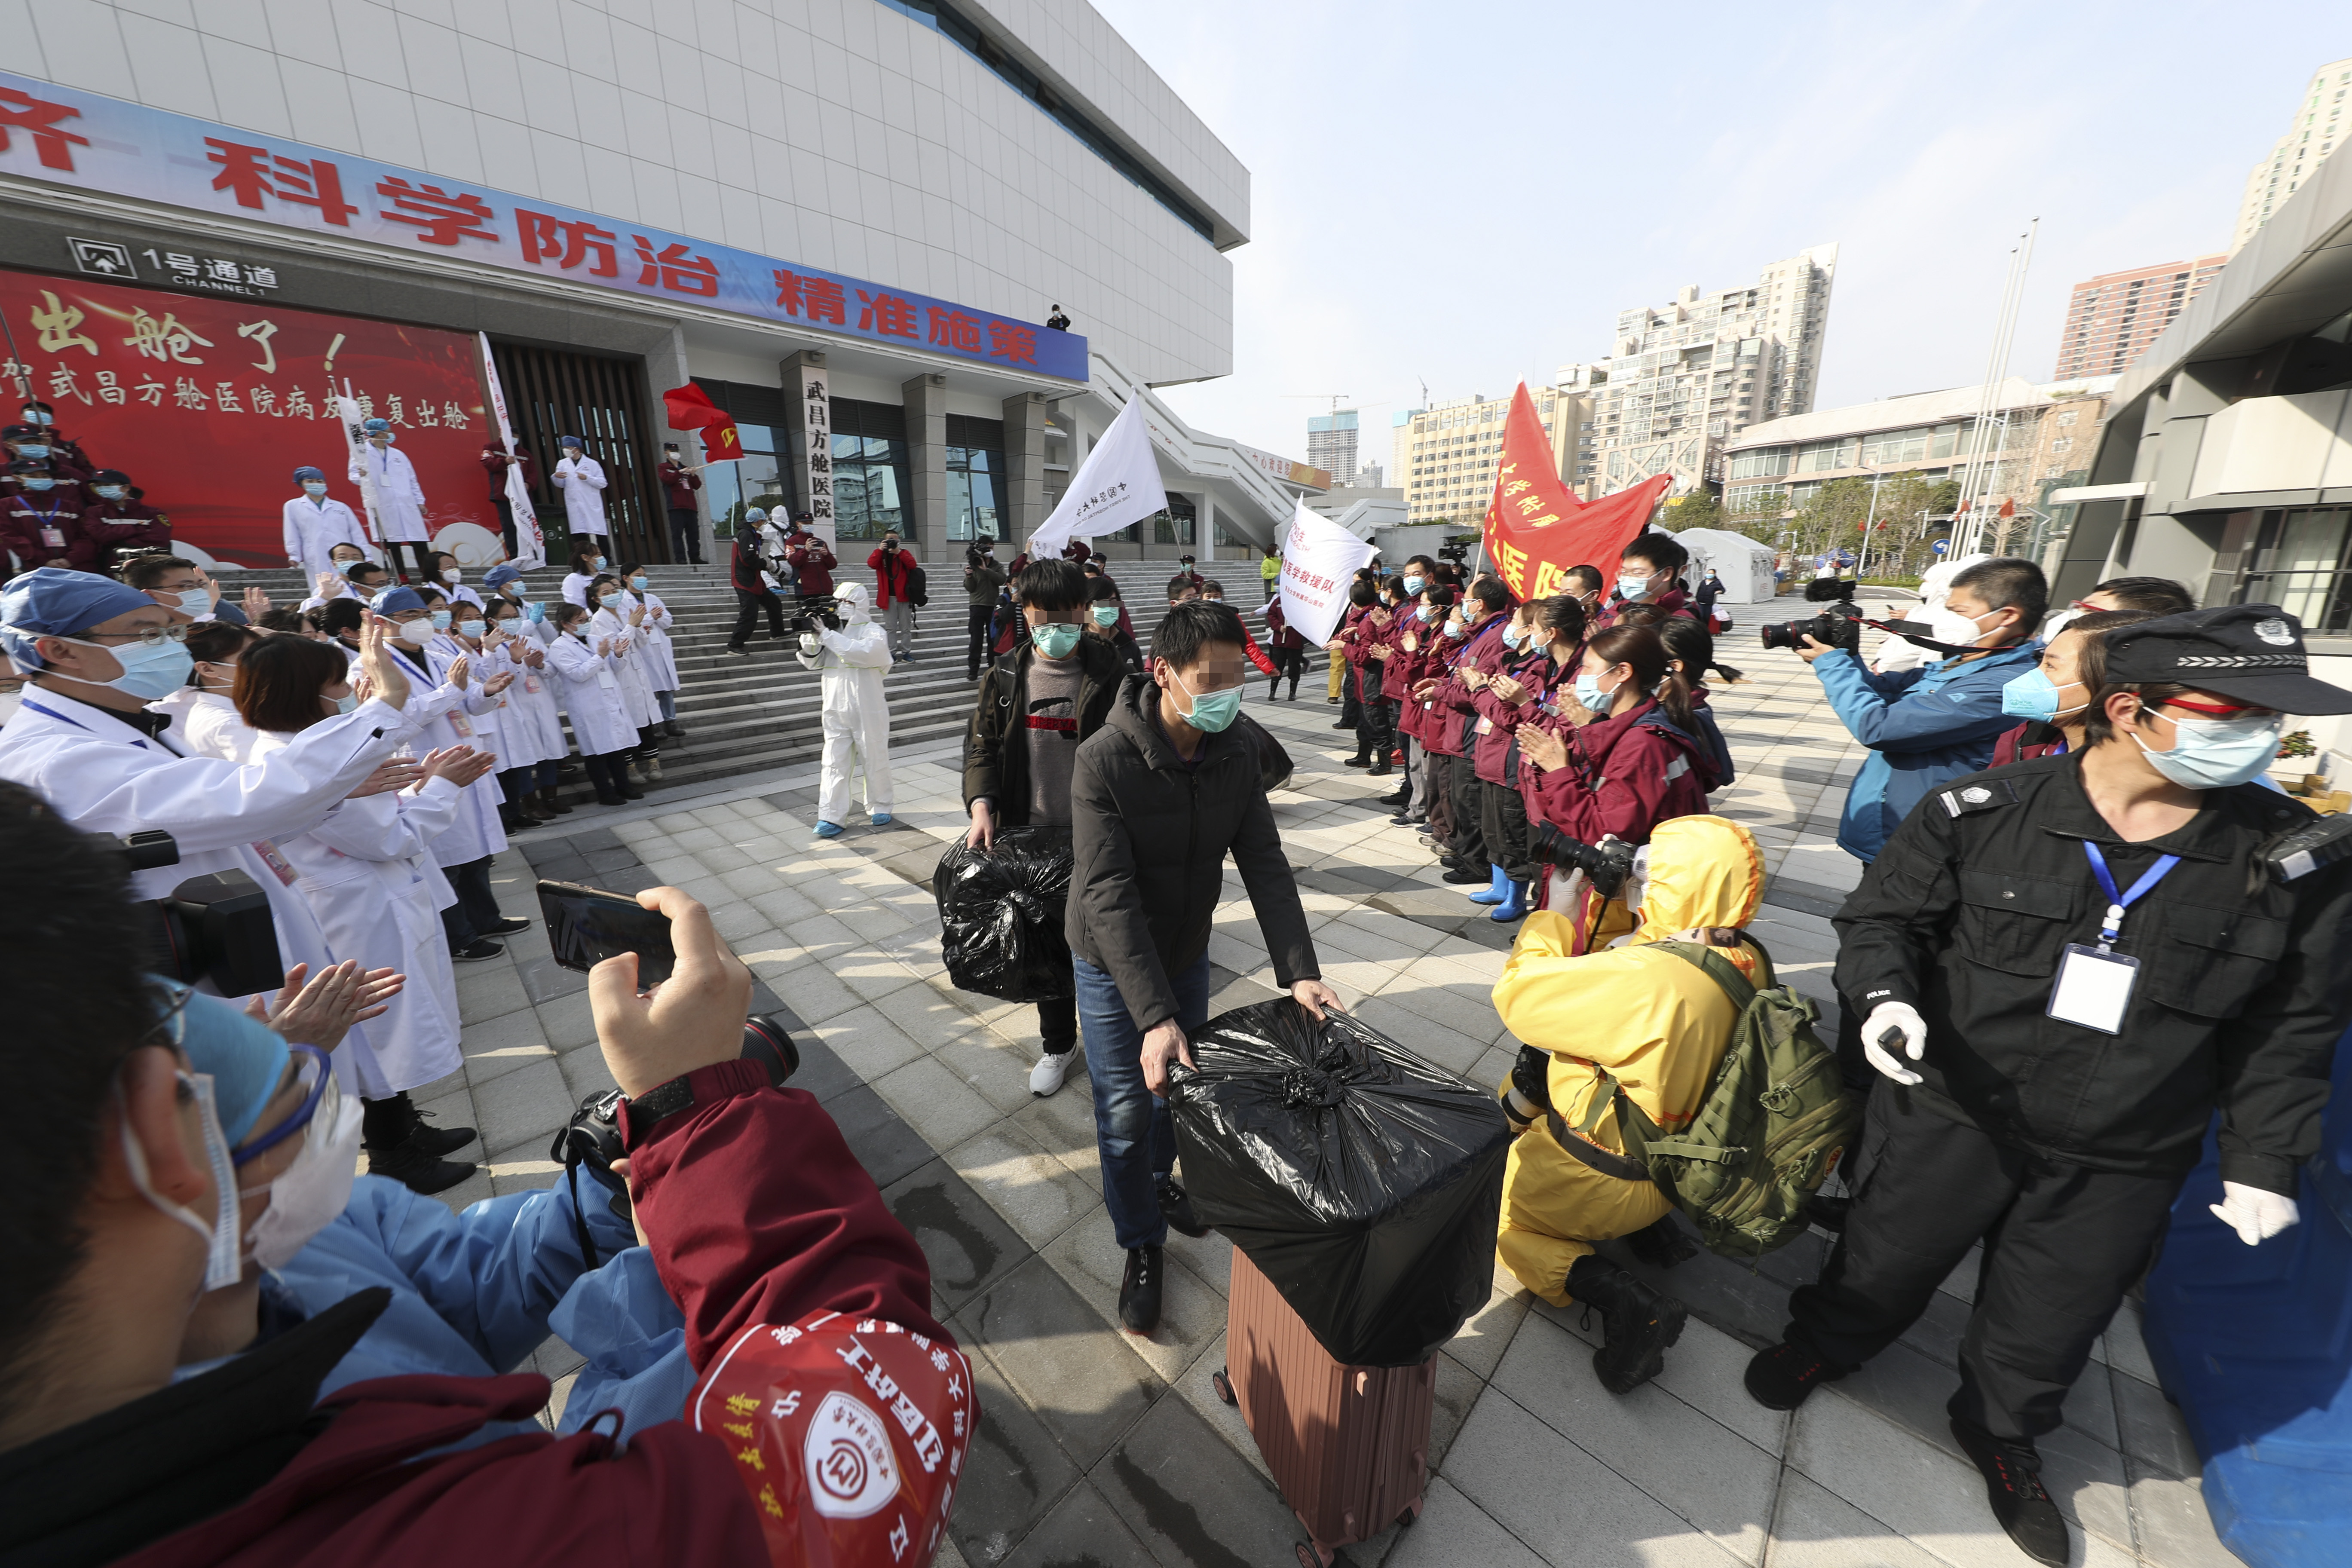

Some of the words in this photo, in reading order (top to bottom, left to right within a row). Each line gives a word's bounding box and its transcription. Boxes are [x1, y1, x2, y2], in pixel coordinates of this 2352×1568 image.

[142, 248, 279, 289] 1号通道
[172, 275, 255, 295] CHANNEL
[204, 135, 720, 297] 科学防治
[774, 268, 1038, 365] 精准施策
[806, 380, 832, 519] 武昌方舱医院
[1866, 989, 1891, 1000] POLICE
[836, 1334, 944, 1473] 红医战士
